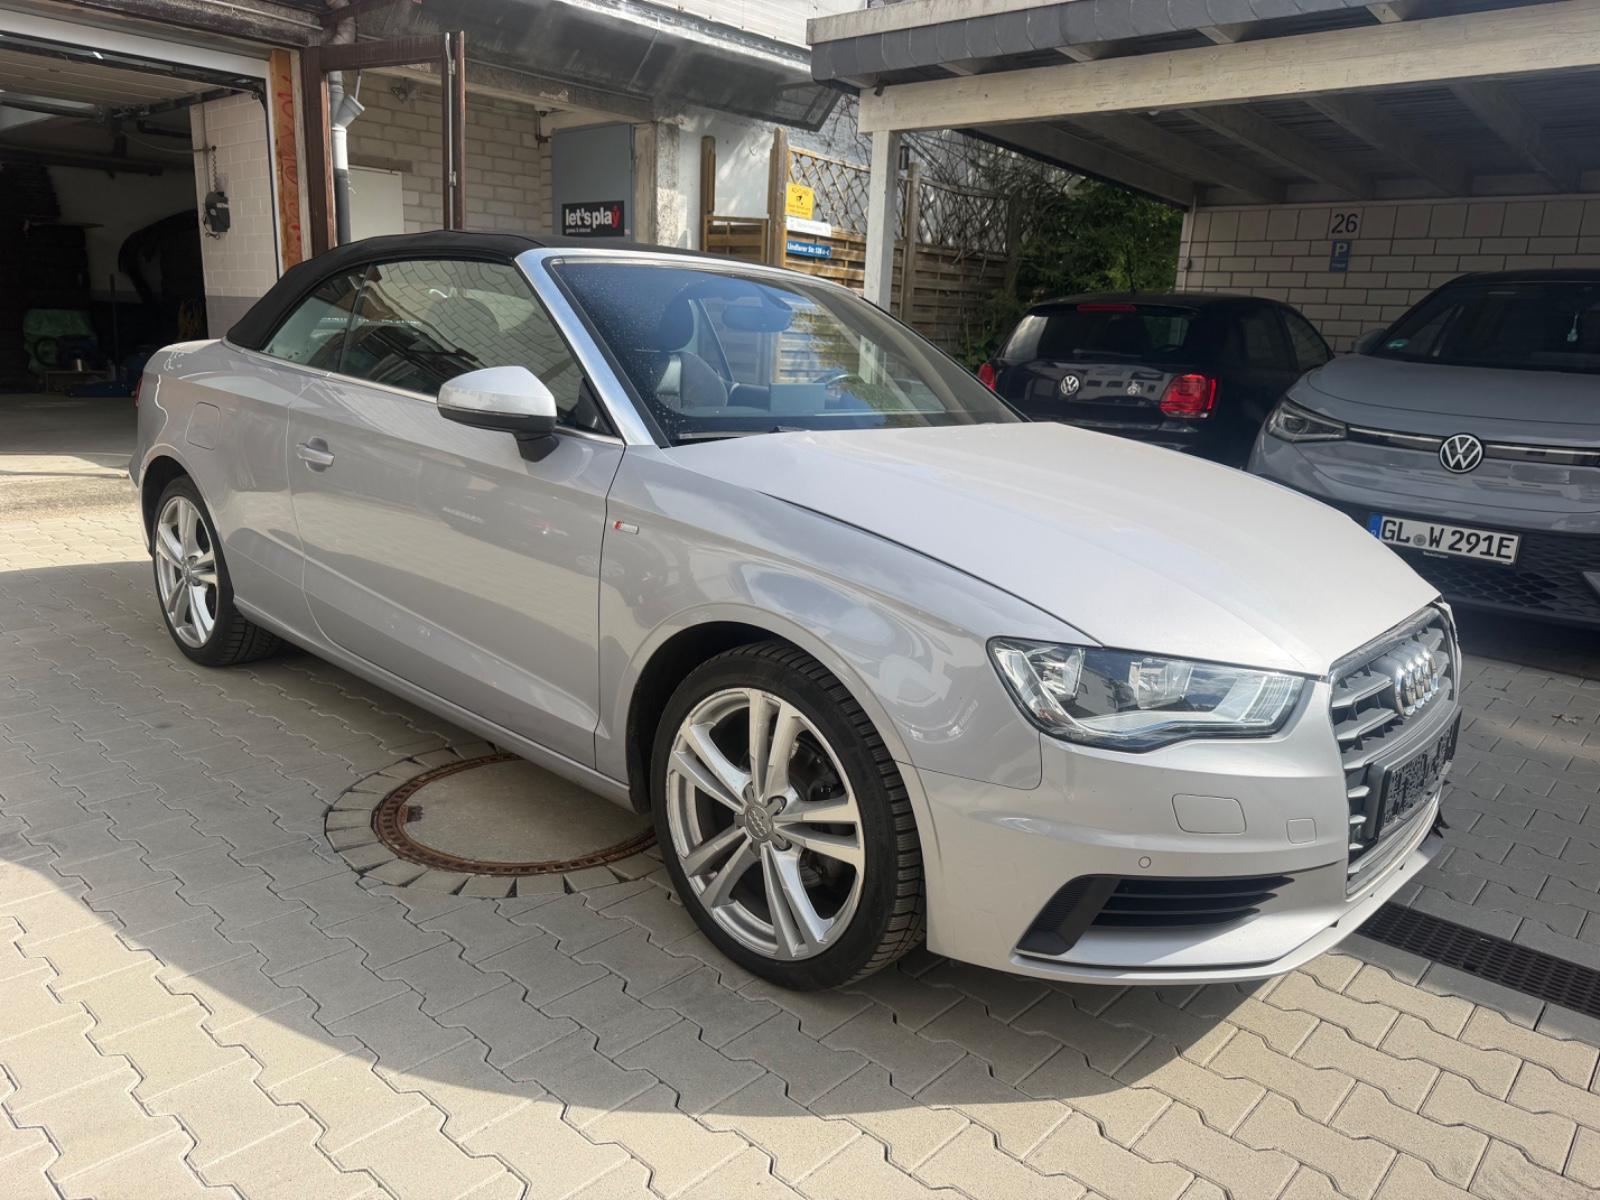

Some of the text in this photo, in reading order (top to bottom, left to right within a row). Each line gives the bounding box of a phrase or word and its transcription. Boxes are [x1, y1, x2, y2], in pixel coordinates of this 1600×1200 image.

[565, 205, 620, 229] let's play
[1331, 213, 1358, 234] 26
[1335, 243, 1348, 257] P
[1440, 434, 1483, 473] VW
[1381, 519, 1515, 560] GL W 291E
